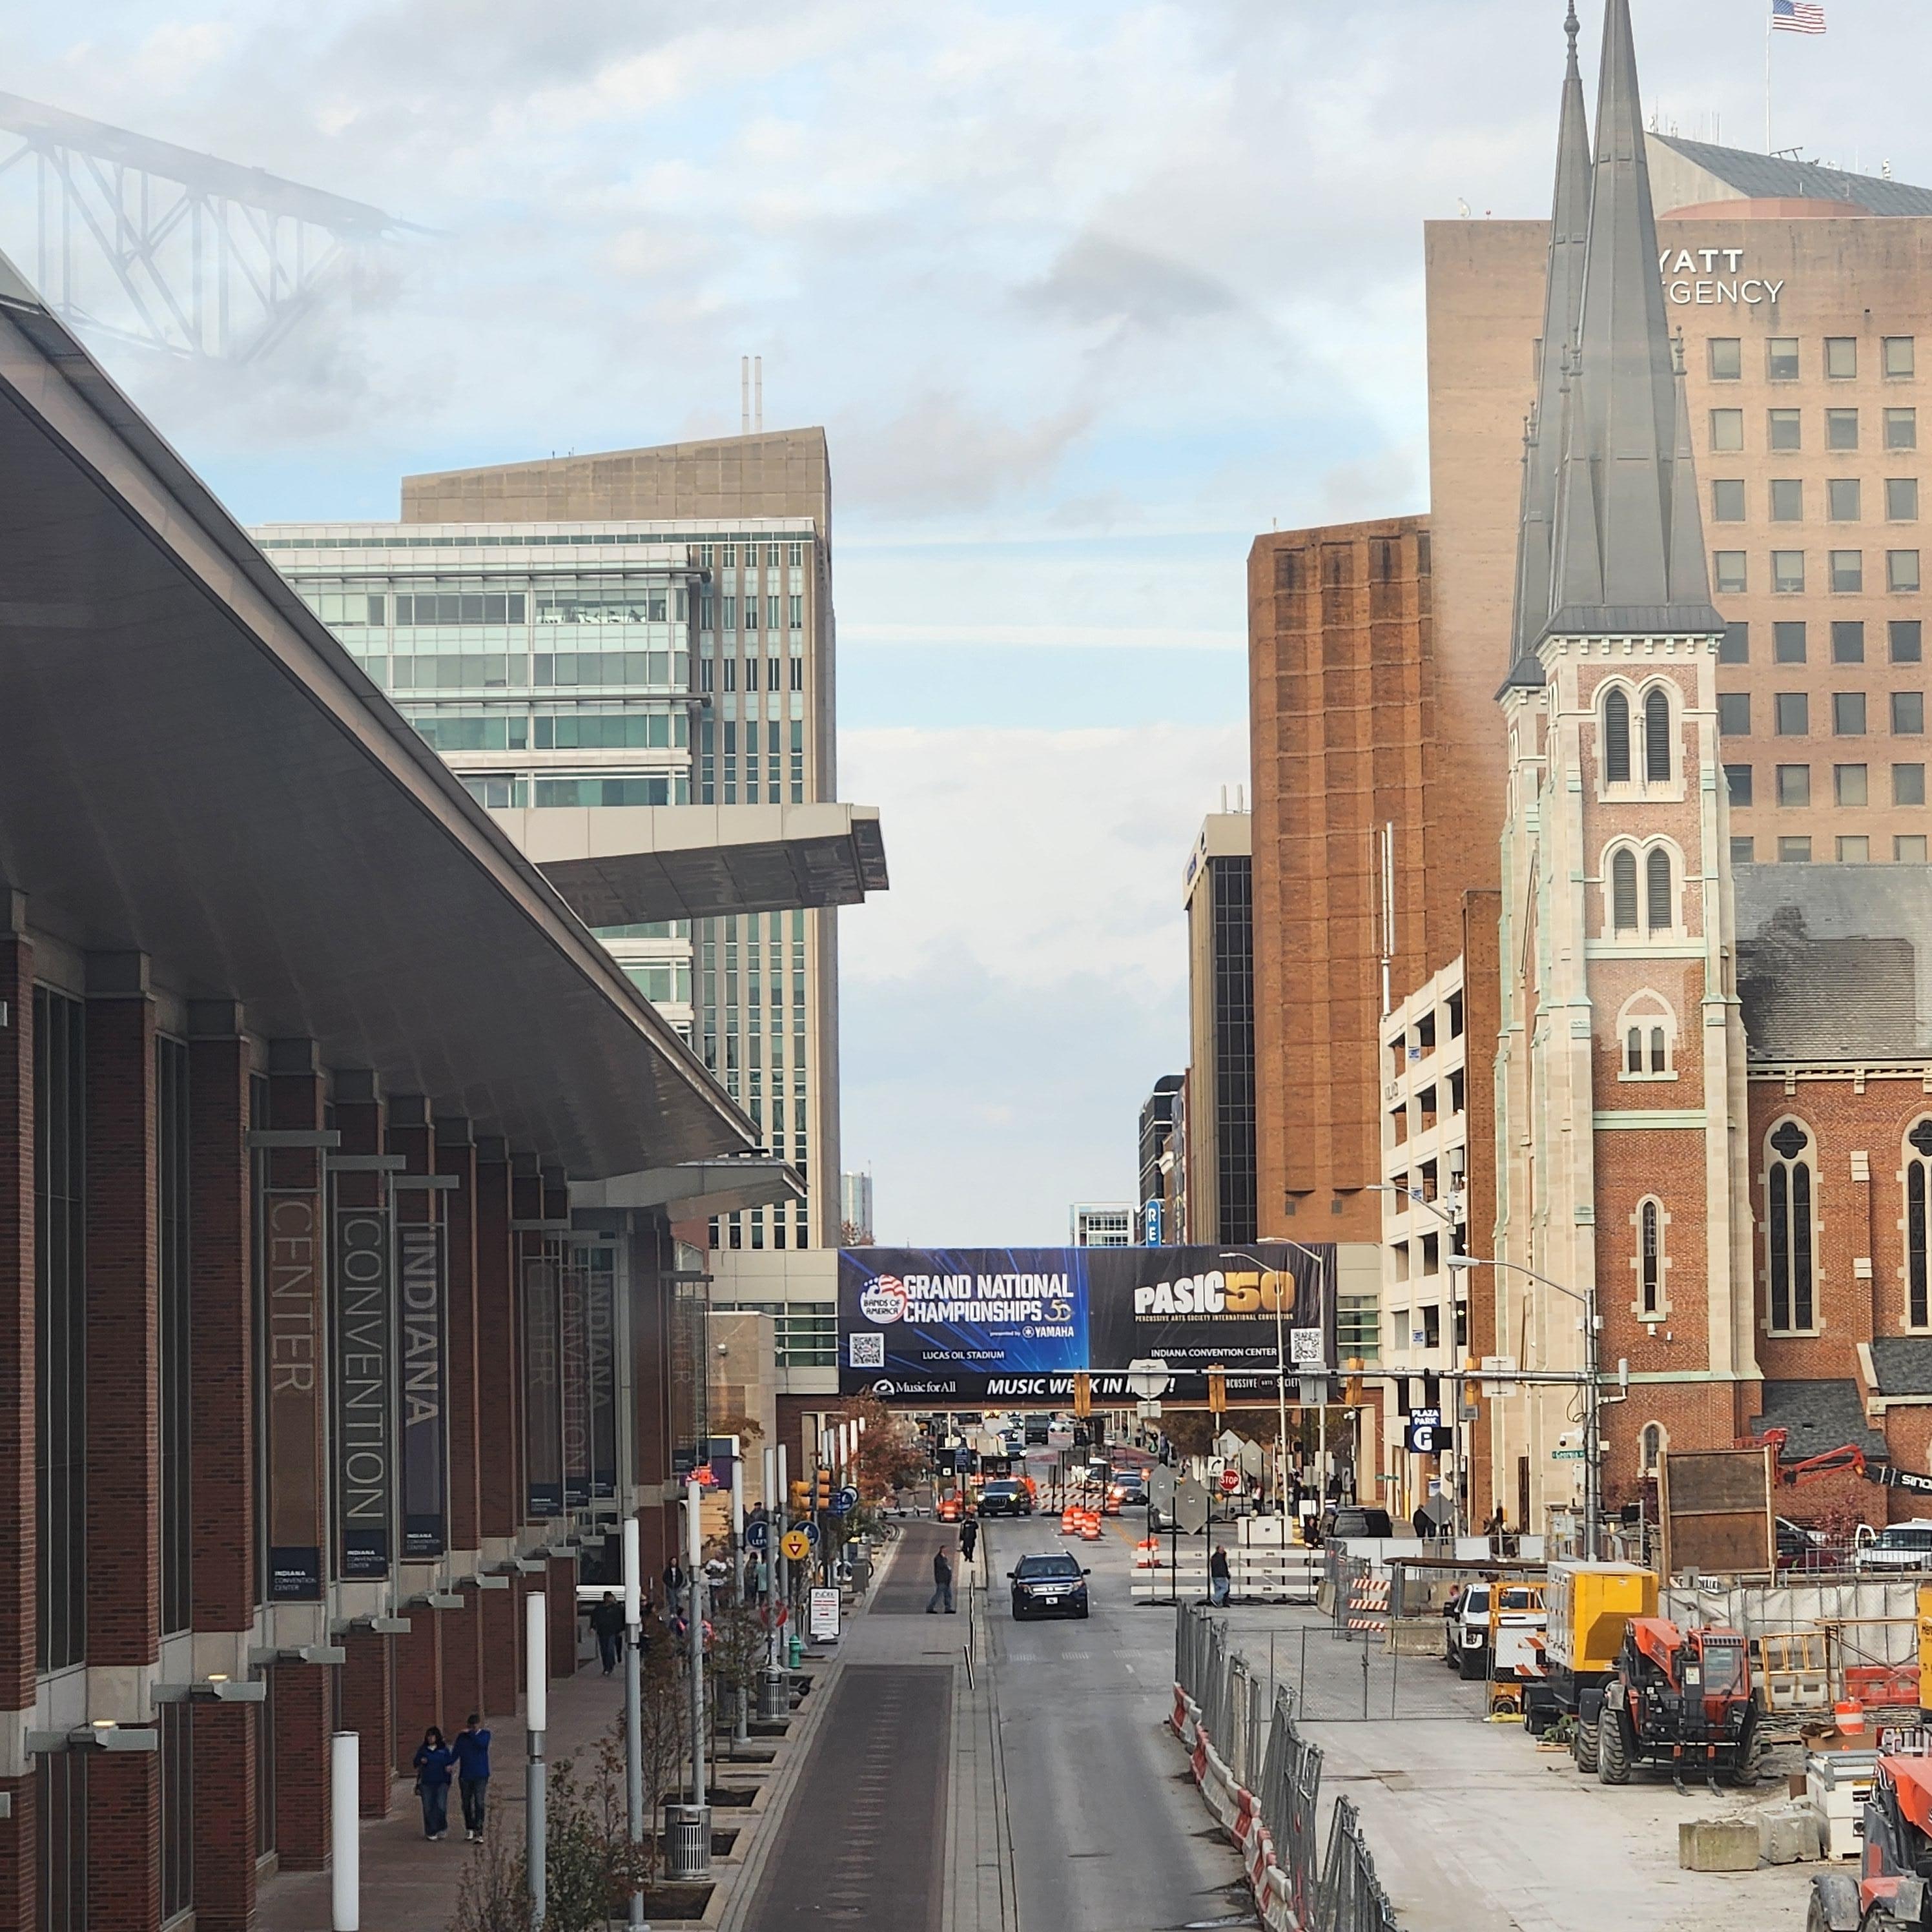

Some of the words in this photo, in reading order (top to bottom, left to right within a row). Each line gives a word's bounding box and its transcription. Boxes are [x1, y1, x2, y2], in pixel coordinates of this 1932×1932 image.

[1661, 280, 1783, 303] GENCY
[903, 1275, 972, 1299] GRAND
[977, 1273, 1074, 1299] NATIONAL
[271, 1200, 313, 1391] CENTER
[903, 1300, 1042, 1322] CHAMPIONSHIPS
[1259, 1313, 1293, 1321] CONVETION
[403, 1231, 440, 1426] INDIANA
[1034, 1326, 1074, 1339] YAMAHA
[922, 1351, 950, 1360] LUCAS
[951, 1351, 963, 1359] OIL
[967, 1350, 1005, 1359] STADIUM
[1151, 1348, 1187, 1358] INDIANA
[1188, 1348, 1242, 1357] CONVENTION
[1245, 1346, 1277, 1356] CENTER
[344, 1218, 384, 1519] CONVENTION
[896, 1381, 925, 1393] Music
[926, 1381, 941, 1392] for
[940, 1380, 956, 1392] All
[987, 1378, 1046, 1395] MUSIC
[1049, 1377, 1100, 1395] WEK
[1102, 1376, 1123, 1393] IN
[1225, 1378, 1257, 1388] RCUSSIVE
[1277, 1377, 1300, 1388] SCIETY
[1220, 1475, 1238, 1485] STOP
